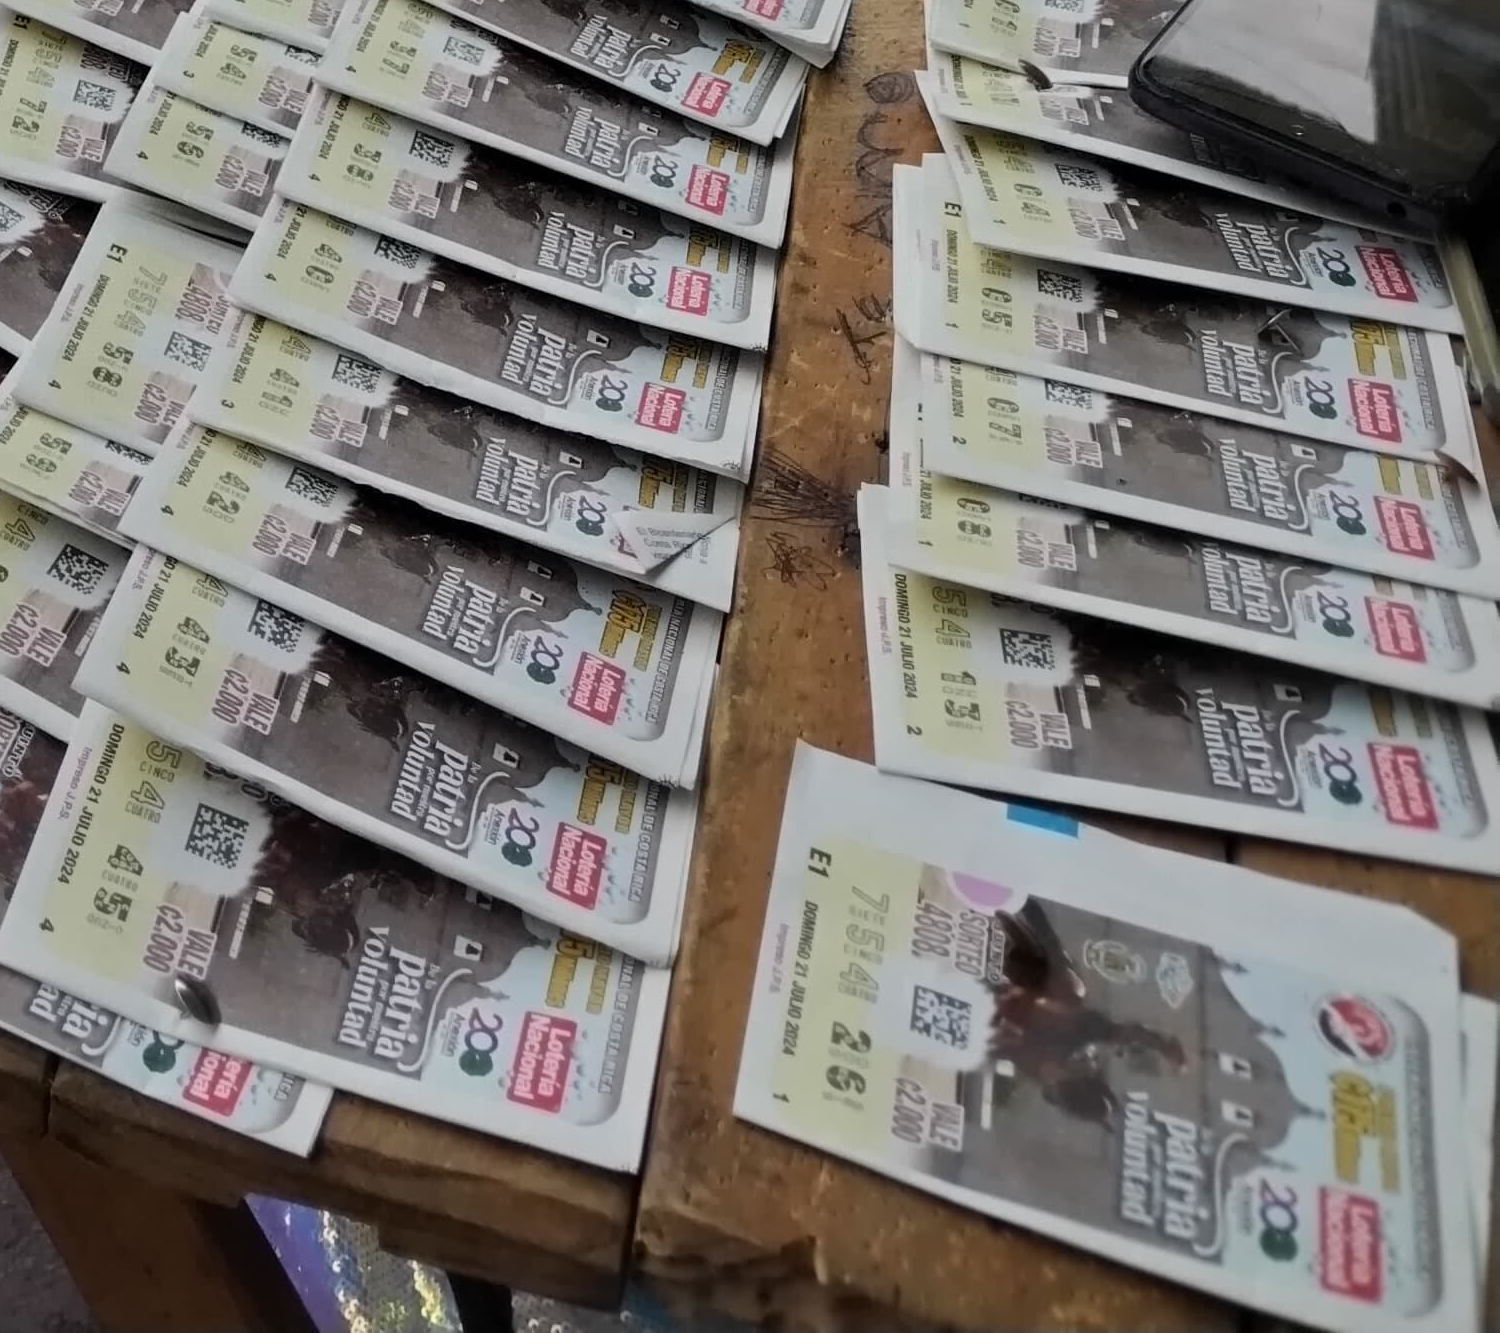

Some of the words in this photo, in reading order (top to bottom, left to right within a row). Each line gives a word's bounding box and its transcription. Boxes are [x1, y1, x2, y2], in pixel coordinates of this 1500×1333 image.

[593, 24, 632, 70] patria
[565, 105, 593, 158] voluntad
[591, 117, 622, 169] patria
[944, 201, 963, 220] E1
[109, 243, 129, 264] E1
[537, 210, 566, 271] voluntad
[565, 222, 599, 283] patria
[1214, 213, 1262, 274] voluntad
[1236, 221, 1290, 279] patria
[501, 313, 537, 384] voluntad
[530, 327, 569, 398] patria
[1060, 326, 1088, 354] VALE
[1200, 327, 1234, 398] voluntad
[1222, 339, 1271, 407] patria
[1353, 378, 1379, 435] Nacional
[475, 436, 506, 506] voluntad
[1075, 440, 1104, 469] VALE
[1219, 438, 1257, 513] voluntad
[97, 490, 133, 517] VALE
[506, 450, 543, 517] patria
[1242, 449, 1296, 523] patria
[282, 534, 316, 565] VALE
[1048, 541, 1078, 572] VALE
[145, 585, 167, 614] JULIO
[421, 564, 465, 641] voluntad
[894, 572, 913, 625] DOMINGO
[1226, 551, 1282, 624] patria
[132, 612, 154, 640] 2024
[452, 578, 498, 655] patria
[898, 624, 912, 642] 21
[26, 624, 67, 668] VALE
[115, 661, 132, 676] 4
[900, 641, 915, 672] JULIO
[573, 653, 605, 713] Nacional
[903, 671, 918, 700] 2024
[244, 691, 280, 735] VALE
[906, 724, 924, 737] 2
[1040, 711, 1073, 750] VALE
[1195, 687, 1242, 789] voluntad
[68, 745, 93, 793] Impreso
[99, 722, 125, 786] DOMINGO
[139, 760, 177, 784] CINCO
[145, 739, 183, 770] 5
[390, 720, 437, 822] voluntad
[1220, 699, 1286, 796] patria
[89, 785, 106, 807] 21
[124, 800, 163, 825] CUATRO
[130, 780, 167, 811] 4
[423, 740, 470, 838] patria
[73, 806, 97, 849] JULIO
[632, 834, 652, 871] COSTA
[57, 848, 81, 886] 2024
[551, 824, 585, 897] Nacional
[807, 845, 833, 879] E1
[37, 916, 55, 934] 4
[795, 899, 819, 963] DOMINGO
[953, 909, 989, 978] SORTEO
[175, 927, 218, 981] VALE
[337, 925, 391, 1049] voluntad
[375, 946, 429, 1060] patria
[788, 980, 807, 1020] JULIO
[513, 1013, 552, 1101] Nacional
[783, 1018, 801, 1057] 2024
[929, 1101, 964, 1152] VALE
[1120, 1091, 1156, 1228] voluntad
[1155, 1108, 1208, 1241] patria
